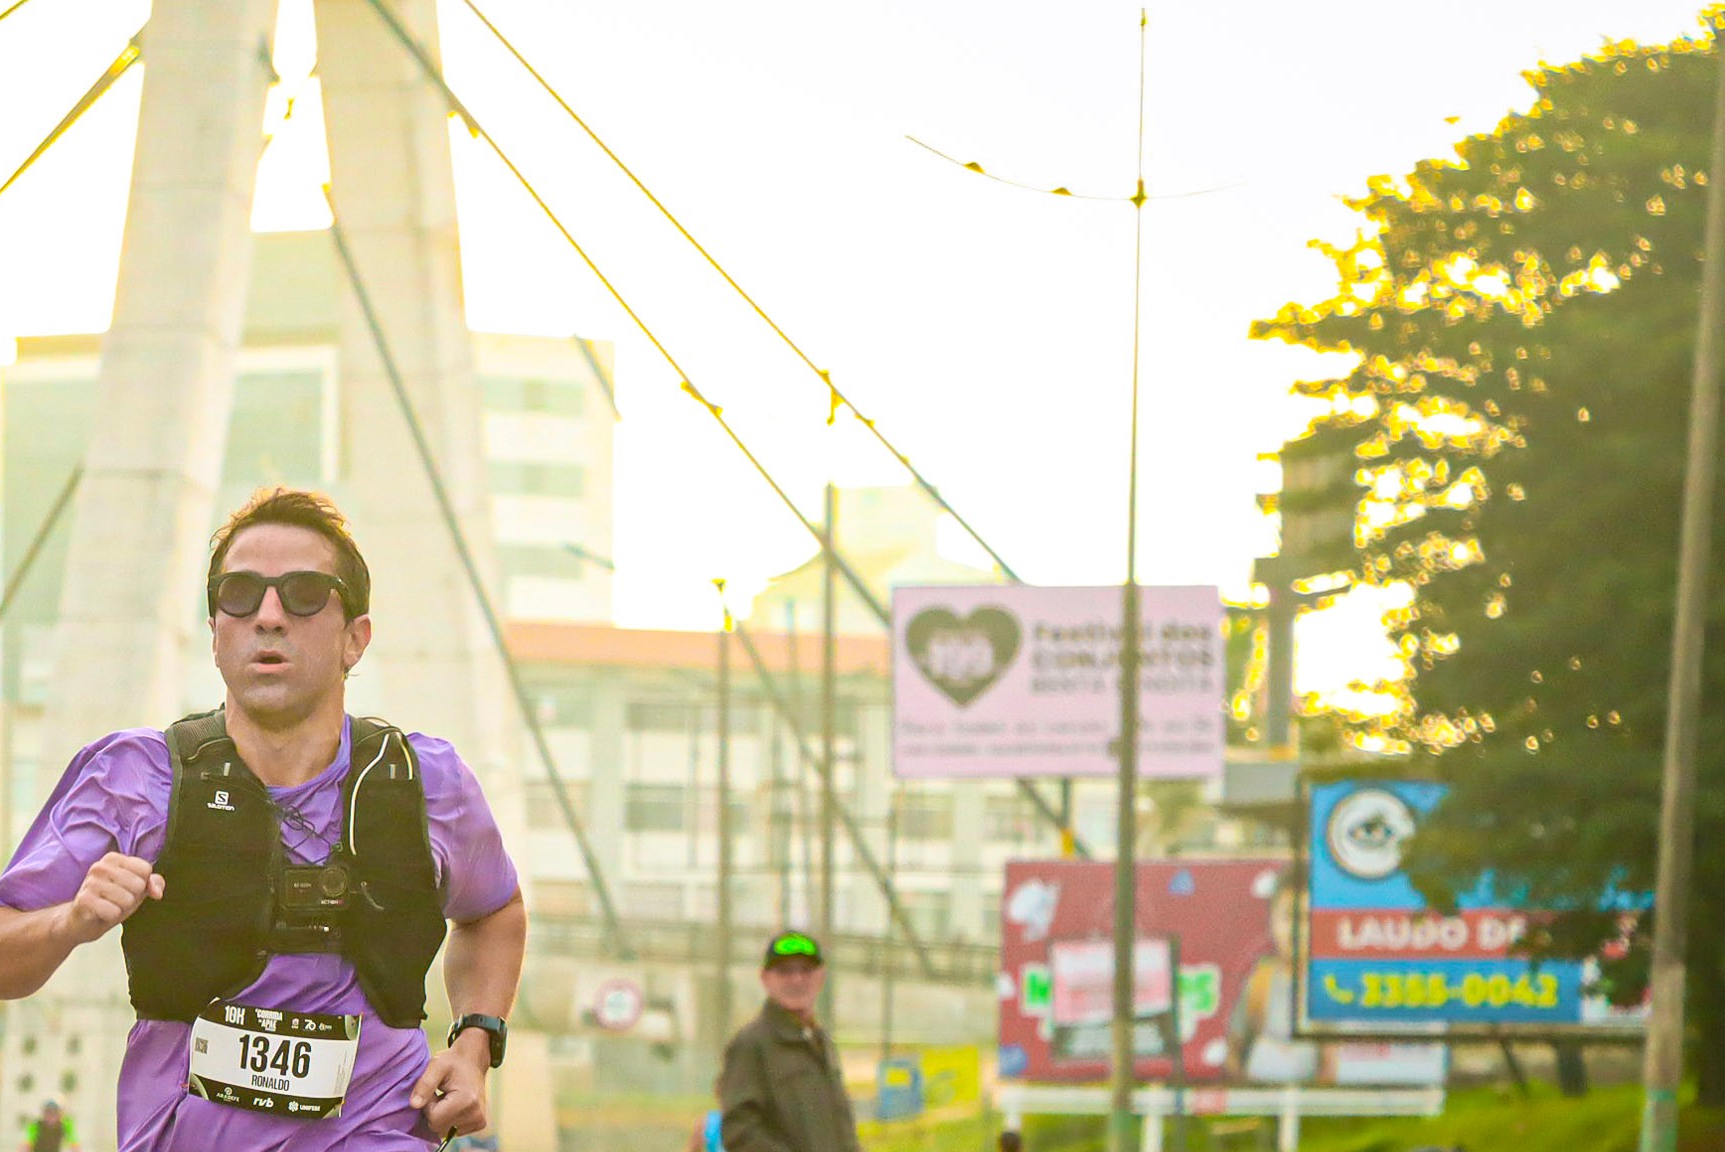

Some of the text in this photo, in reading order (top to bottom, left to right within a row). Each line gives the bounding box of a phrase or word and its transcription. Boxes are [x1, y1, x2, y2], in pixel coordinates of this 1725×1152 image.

[1337, 915, 1469, 951] LAUDO
[238, 1033, 312, 1079] 1346
[251, 1074, 290, 1092] RONALDO
[252, 1097, 274, 1108] rvb
